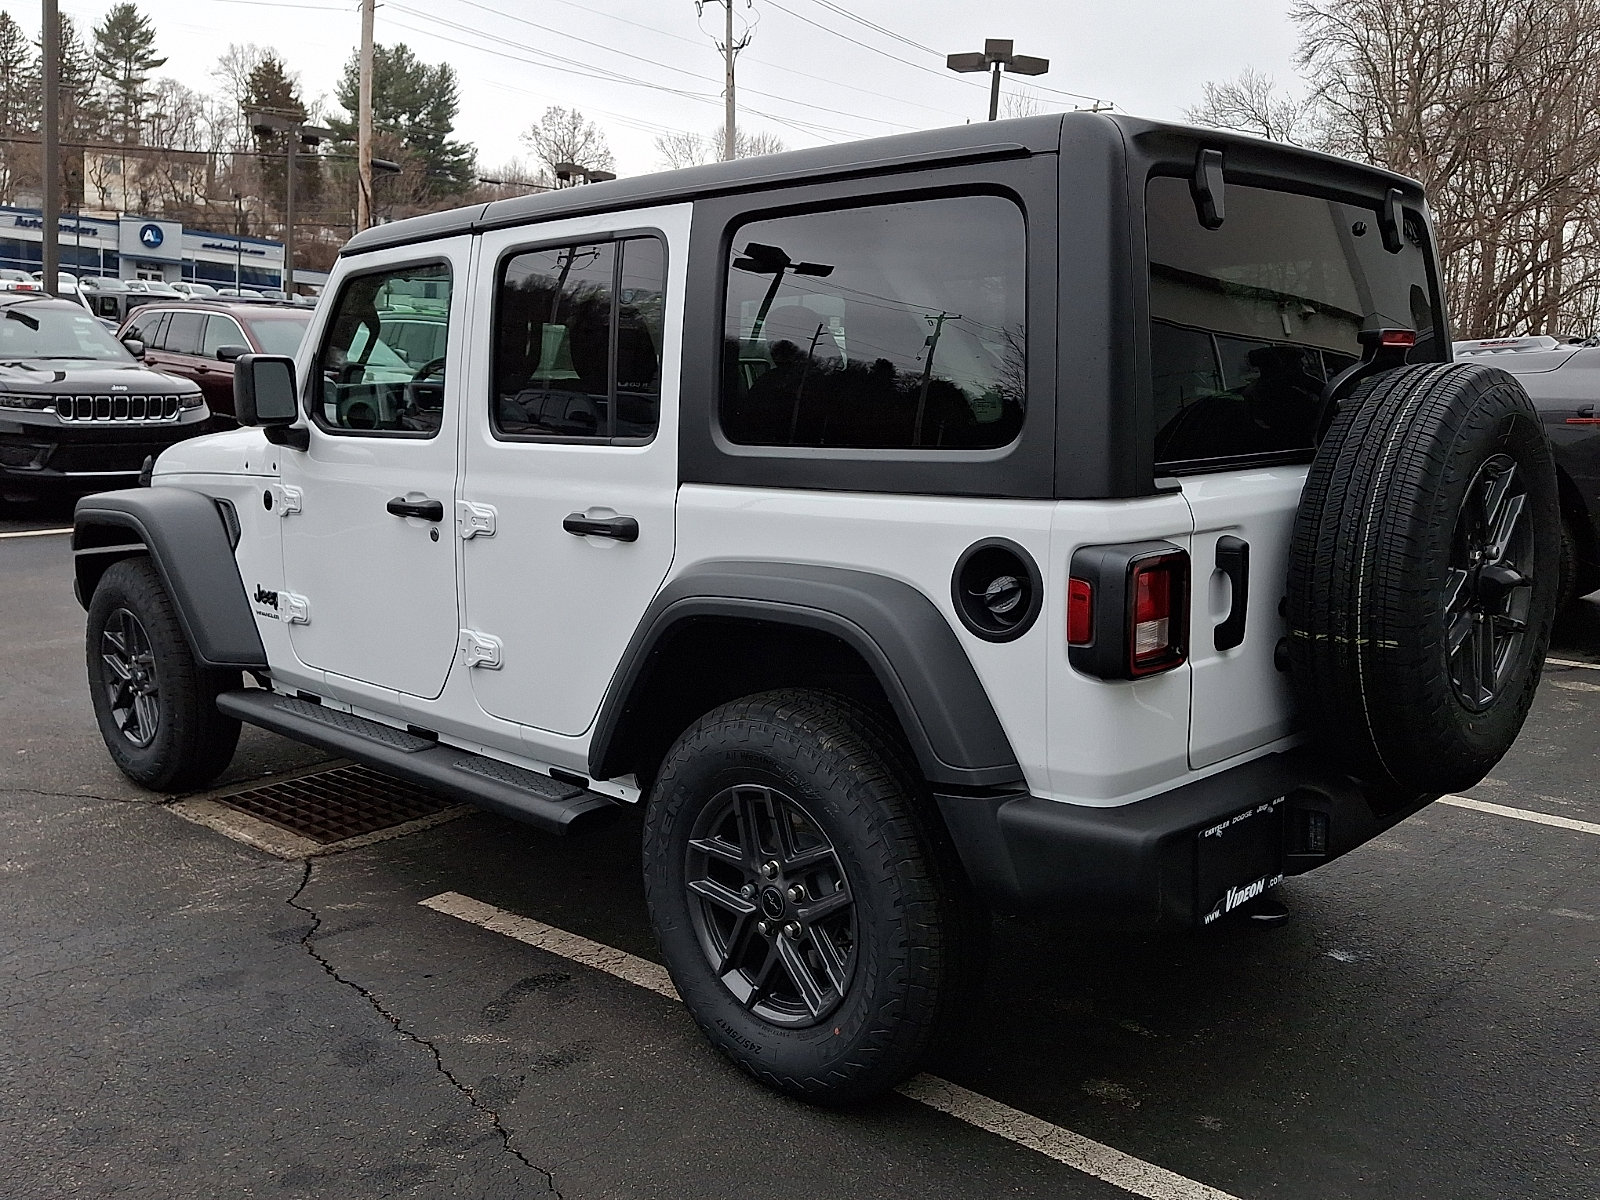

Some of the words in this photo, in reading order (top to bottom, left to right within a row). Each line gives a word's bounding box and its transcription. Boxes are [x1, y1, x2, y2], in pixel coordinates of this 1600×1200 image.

[254, 583, 279, 611] Jeep
[1232, 809, 1253, 824] DODGE
[715, 1018, 763, 1055] 245/75R17
